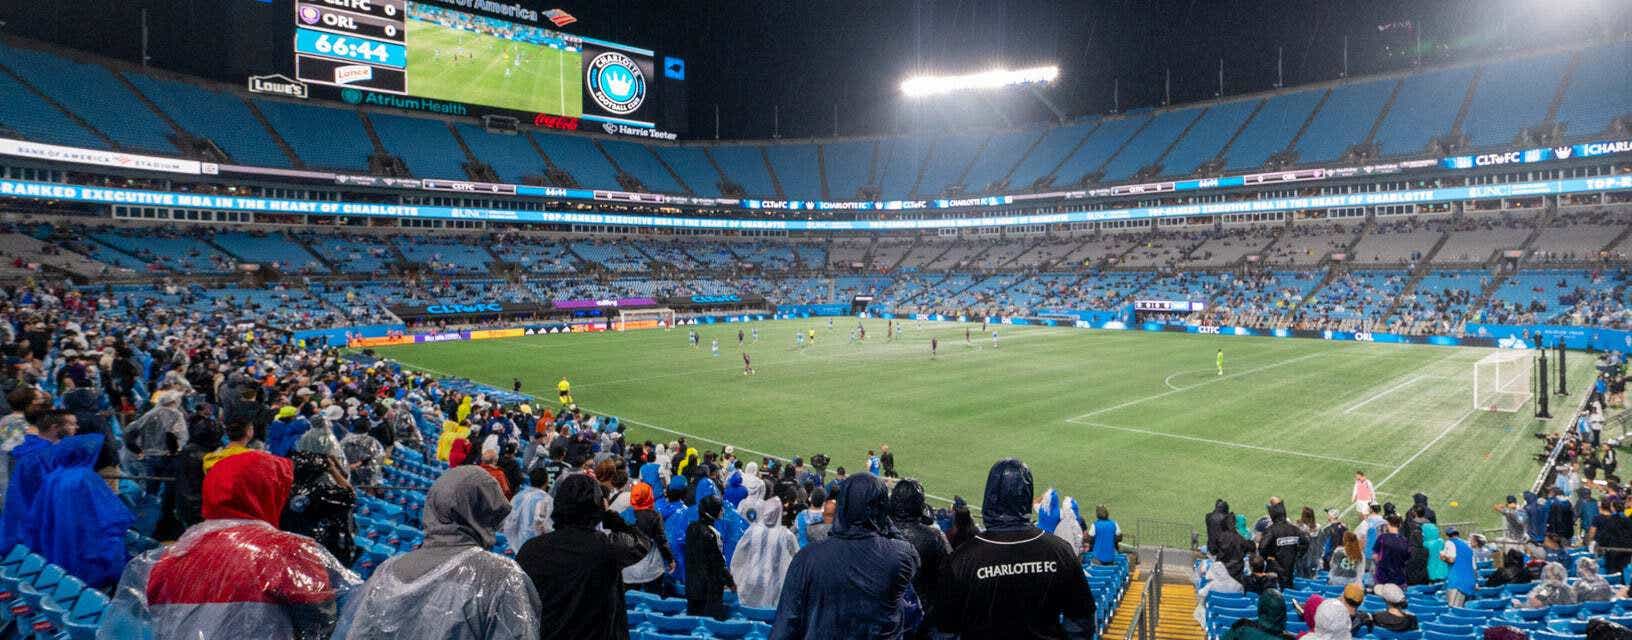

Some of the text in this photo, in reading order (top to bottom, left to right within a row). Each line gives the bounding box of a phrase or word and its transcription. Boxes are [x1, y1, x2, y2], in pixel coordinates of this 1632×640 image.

[325, 0, 397, 17] TFC 0
[474, 0, 538, 21] America
[322, 12, 397, 37] ORL 0
[315, 34, 390, 63] 66:44
[595, 54, 640, 77] CHARLOTTE
[366, 92, 467, 116] Atrium Health
[596, 91, 627, 111] FOOTBALL
[619, 125, 678, 141] Harris Teeter
[82, 188, 173, 205] EXECUTIVE
[178, 194, 213, 207] MBA
[217, 198, 231, 208] IN
[237, 199, 265, 210] THE
[270, 201, 316, 212] HEART
[320, 203, 339, 213] OF
[343, 205, 418, 216] CHARLOTTE
[1355, 331, 1374, 341] ORL
[977, 561, 1057, 579] CHARLOTTE FC
